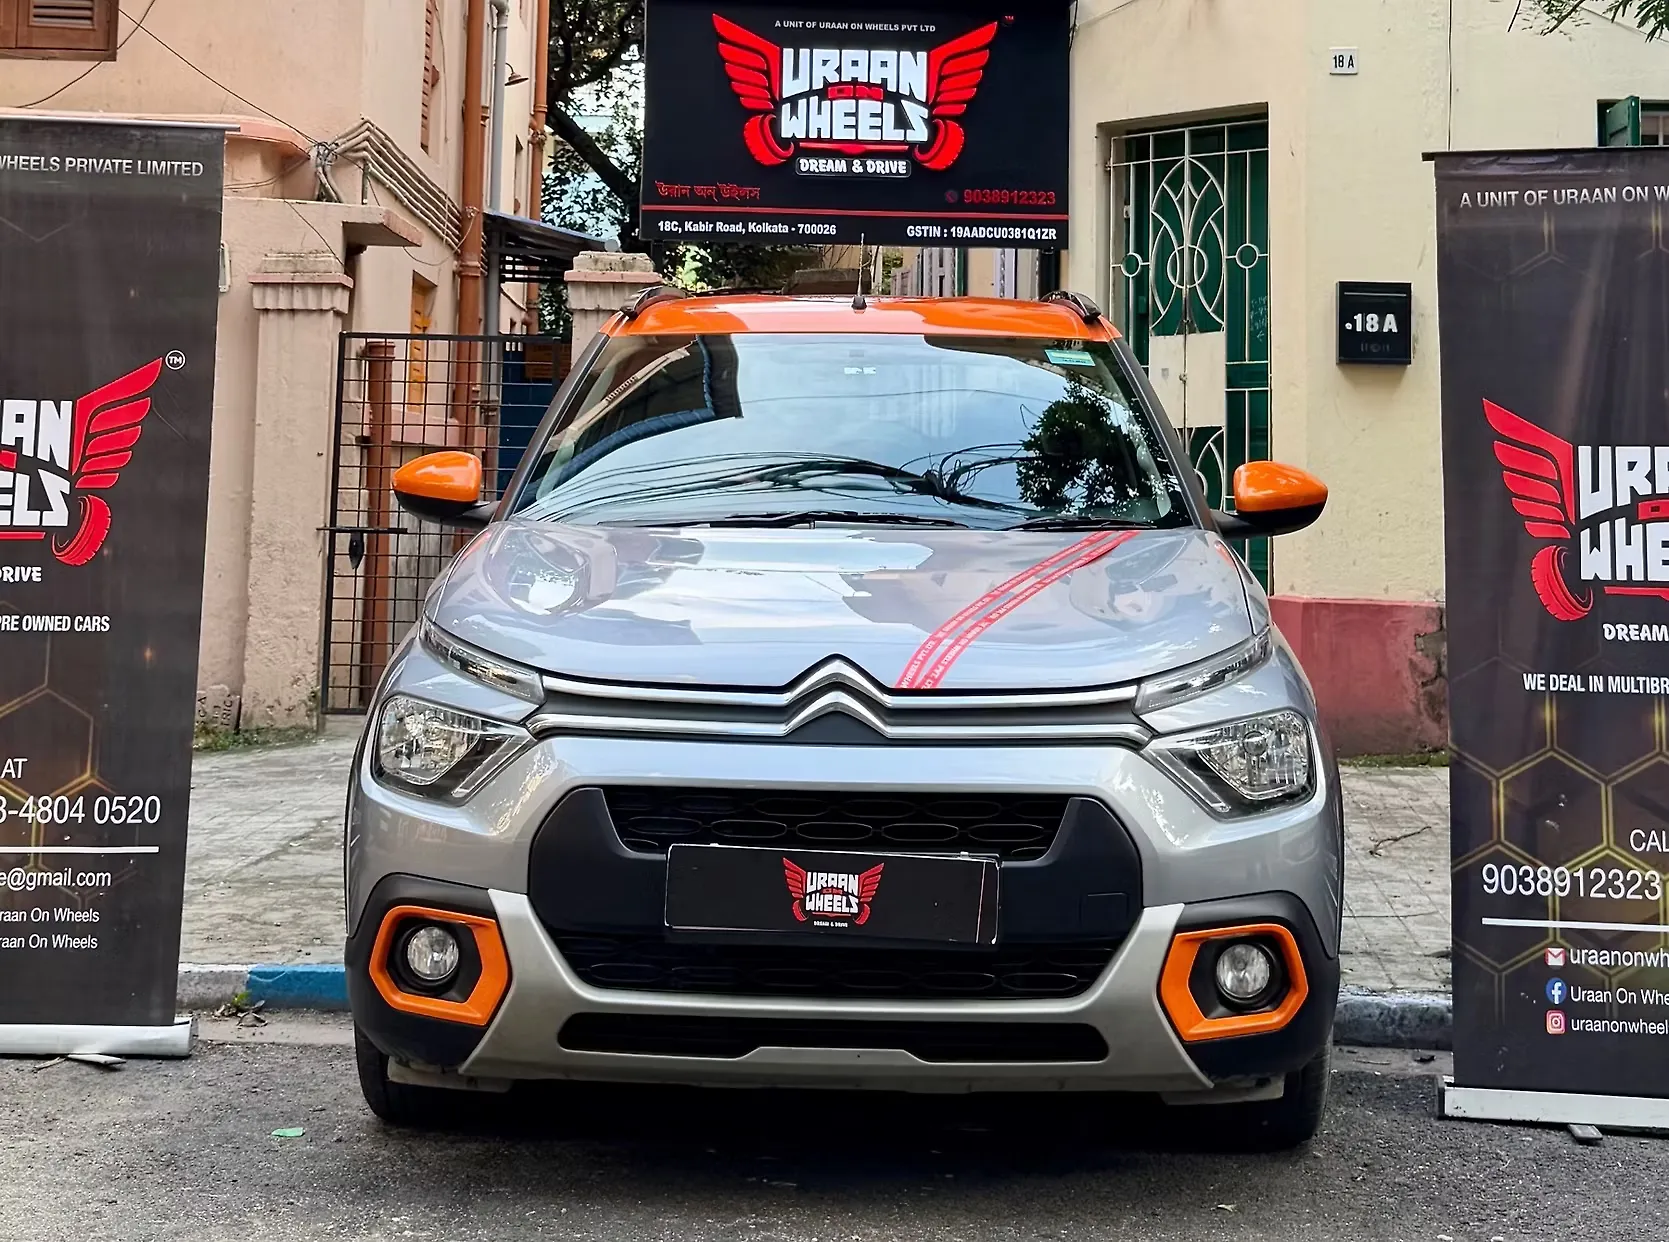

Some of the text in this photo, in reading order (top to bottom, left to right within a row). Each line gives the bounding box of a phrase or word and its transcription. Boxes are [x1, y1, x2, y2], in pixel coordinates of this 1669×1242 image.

[775, 20, 781, 28] A
[806, 21, 816, 29] OF
[819, 22, 848, 30] URAAN
[850, 22, 863, 30] ON
[865, 23, 899, 31] WHEELS
[901, 24, 918, 32] PVT
[920, 24, 936, 32] LTD
[782, 48, 928, 103] URAAN
[828, 85, 884, 100] ON
[781, 96, 928, 142] WHEELS
[65, 157, 133, 175] PRIVATE
[138, 160, 204, 177] LIMITED
[800, 158, 907, 174] DREAM & DRIVE
[963, 189, 1056, 205] 9038912323
[1460, 192, 1472, 208] A
[1477, 190, 1520, 208] UNIT
[1524, 190, 1548, 206] OF
[1554, 186, 1617, 205] URAAN
[1622, 186, 1649, 202] ON
[658, 220, 682, 234] 18C,
[684, 220, 713, 233] Kabir
[716, 221, 746, 235] Road,
[748, 222, 789, 234] Kolkata
[798, 223, 837, 235] 700026
[906, 225, 941, 238] GSTIN
[0, 566, 42, 582] RIVE
[0, 614, 110, 632] RE OWNED CARS
[1602, 623, 1669, 642] DREAM
[1522, 673, 1546, 691] WE
[1550, 674, 1586, 692] DEAL
[1588, 675, 1604, 693] IN
[1, 758, 28, 779] AT
[94, 795, 161, 824] 0520
[1630, 829, 1669, 853] CAL
[806, 871, 859, 897] URAAN
[1482, 863, 1662, 901] 9038912323
[805, 892, 859, 914] WHEELS
[30, 907, 50, 922] On
[54, 907, 100, 922] Wheels
[28, 934, 48, 949] On
[52, 934, 98, 949] Wheels
[1570, 947, 1669, 968] uraanonwh
[1570, 985, 1669, 1006] Uraan On Whe
[1571, 1018, 1668, 1035] uraanonwheel
